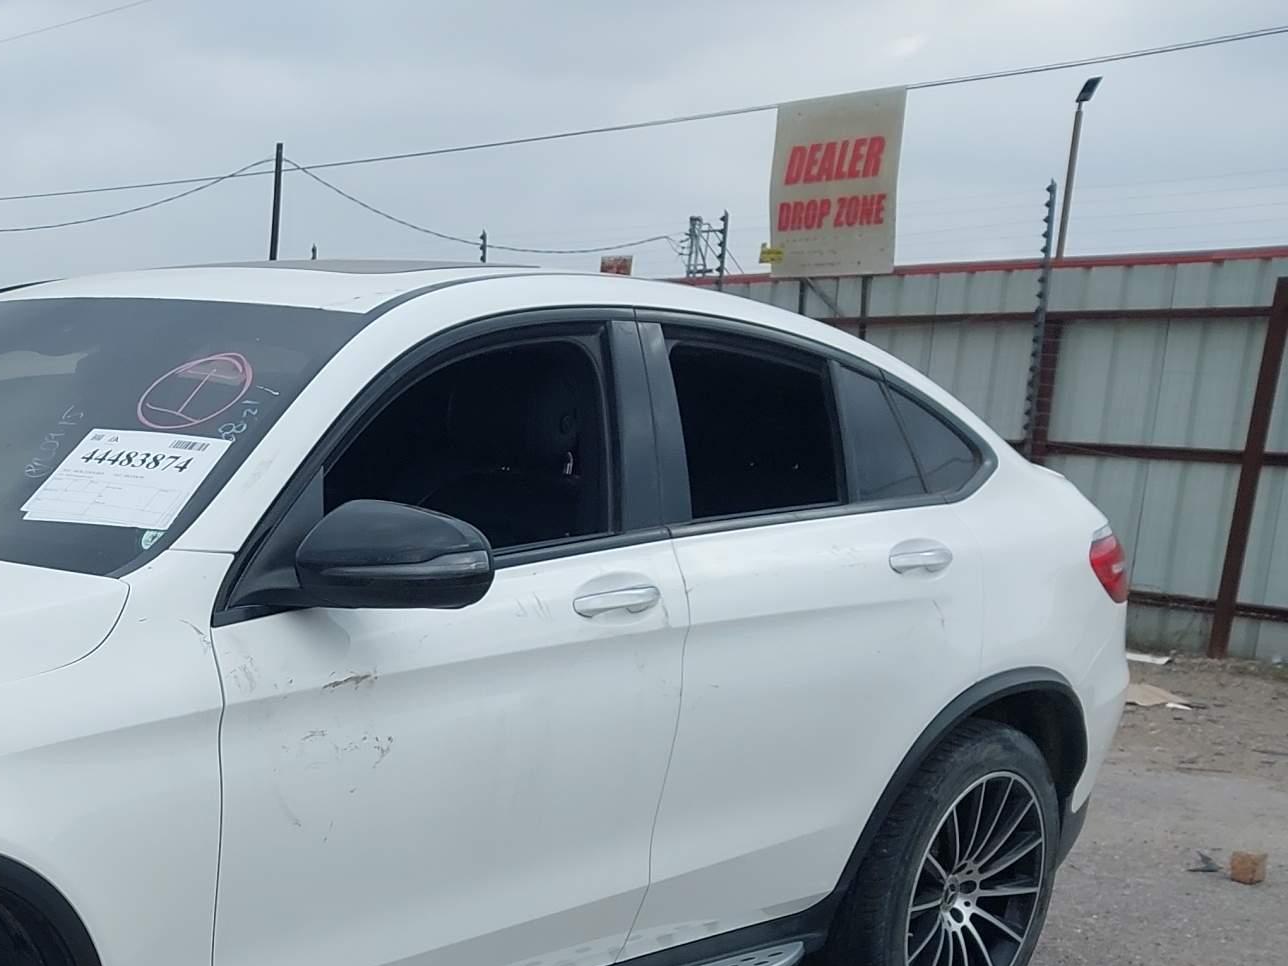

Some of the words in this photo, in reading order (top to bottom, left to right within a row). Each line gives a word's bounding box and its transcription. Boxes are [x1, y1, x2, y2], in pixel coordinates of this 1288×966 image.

[784, 136, 886, 186] DEALER
[777, 197, 831, 232] DROP
[833, 194, 887, 228] ZONE
[81, 448, 194, 472] 44483874
